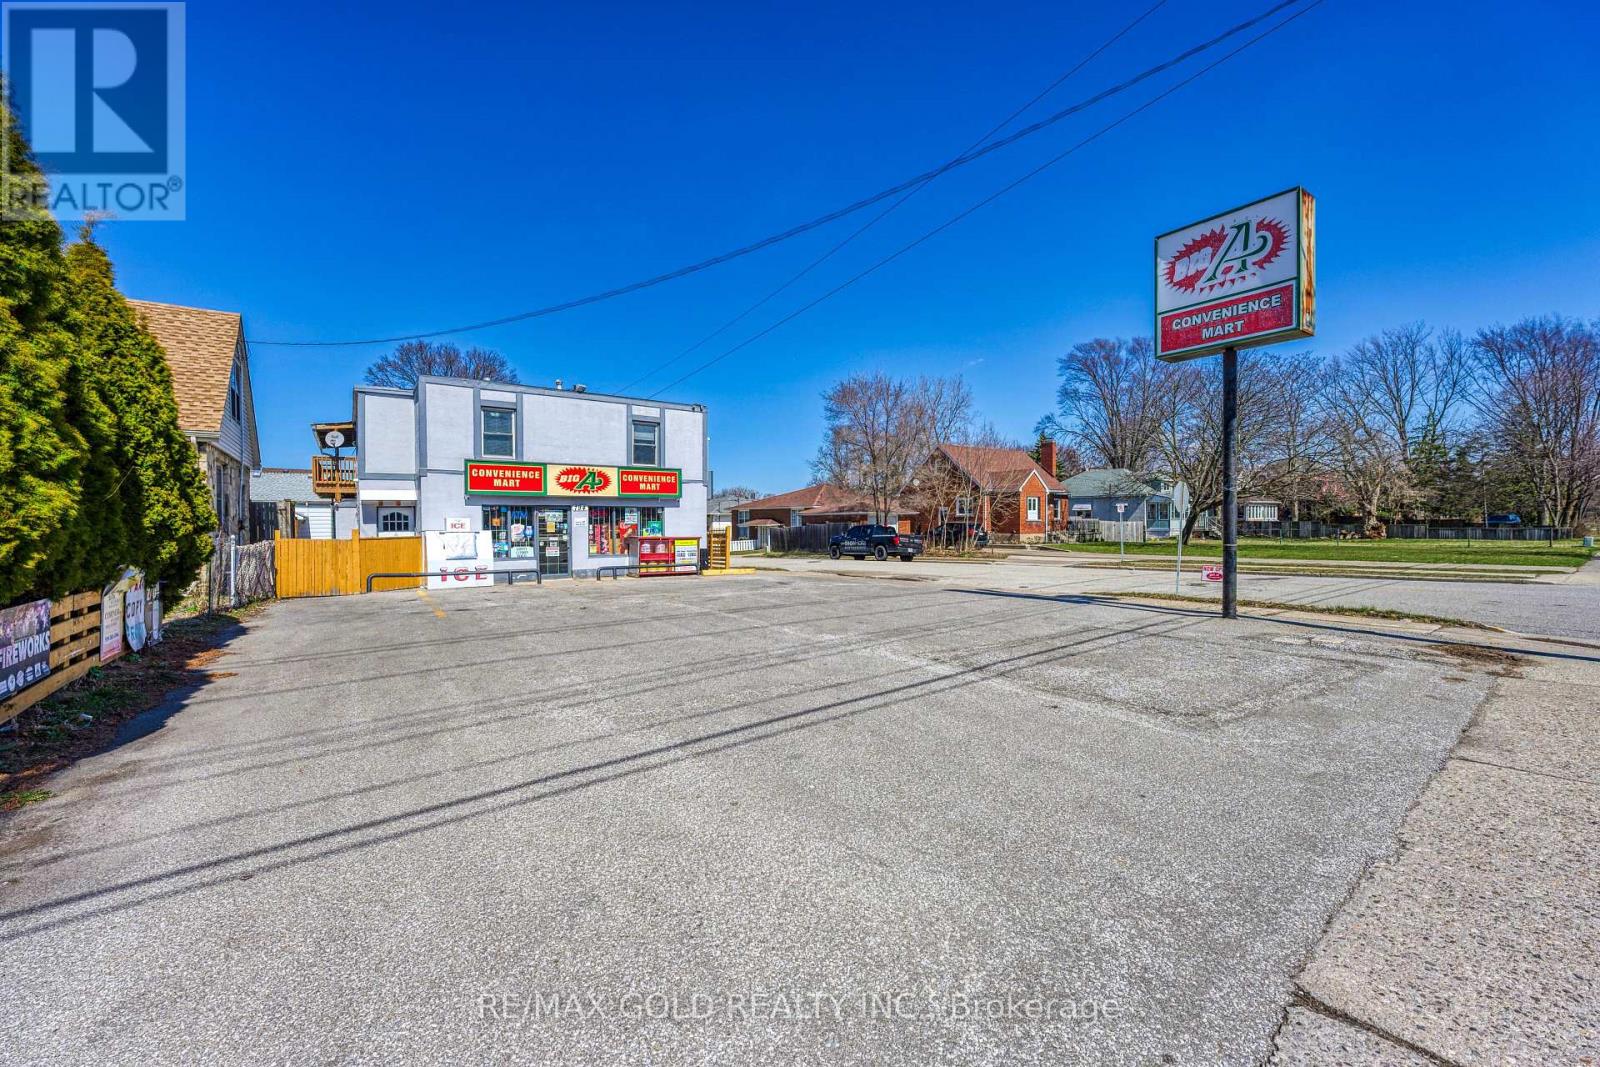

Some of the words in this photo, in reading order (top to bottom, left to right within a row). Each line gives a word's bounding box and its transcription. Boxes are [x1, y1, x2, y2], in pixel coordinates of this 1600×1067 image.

[1172, 295, 1281, 330] CONVENIENCE
[1201, 319, 1245, 339] MART
[472, 469, 540, 479] CONVENIENCE
[558, 474, 581, 484] BIG
[493, 478, 520, 488] MART
[622, 475, 676, 484] CONVENIENCE
[639, 483, 660, 491] MART
[440, 565, 488, 582] ICE
